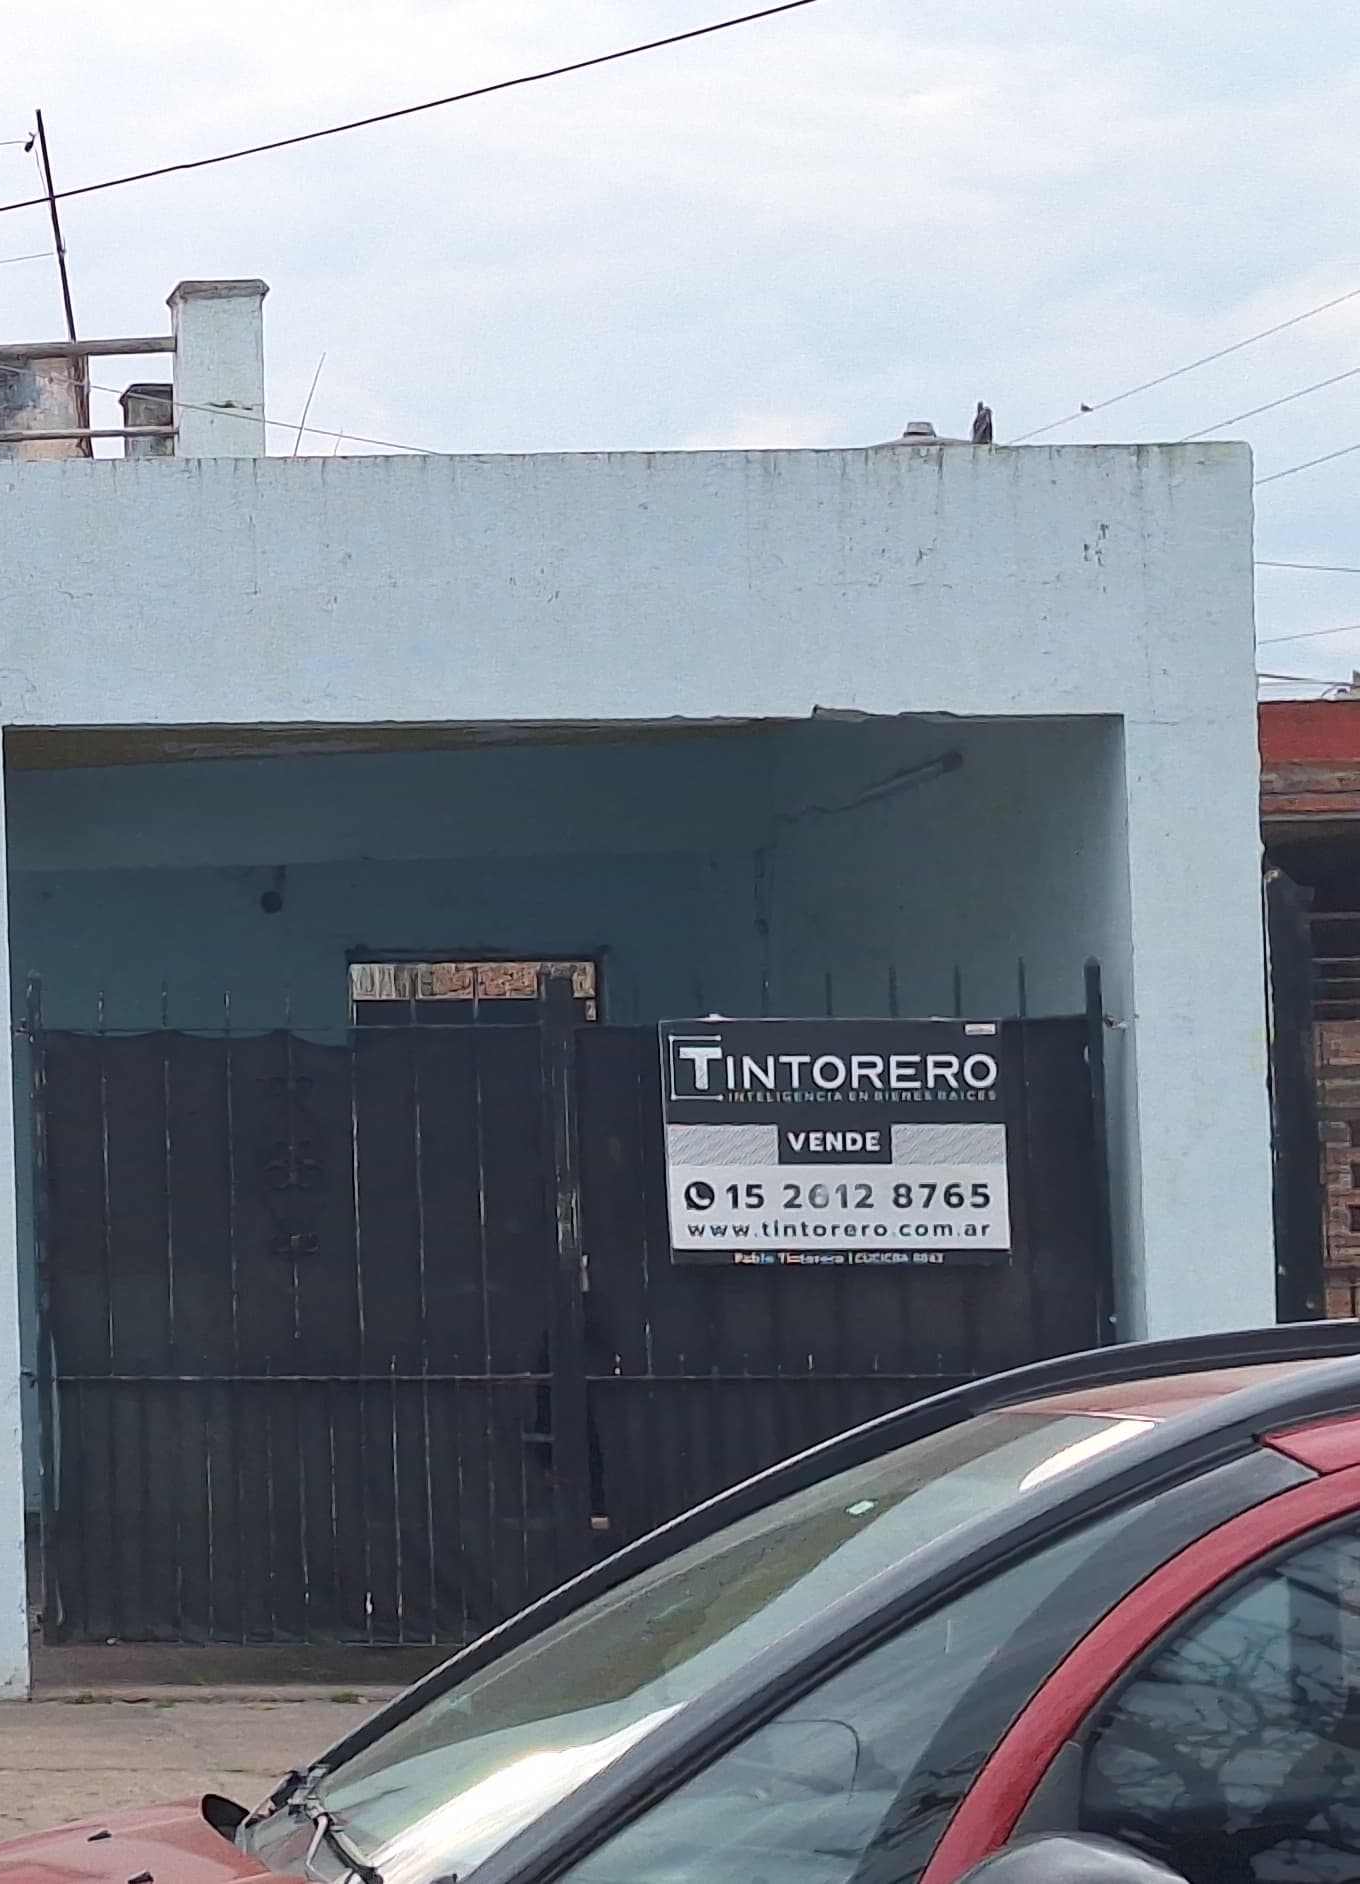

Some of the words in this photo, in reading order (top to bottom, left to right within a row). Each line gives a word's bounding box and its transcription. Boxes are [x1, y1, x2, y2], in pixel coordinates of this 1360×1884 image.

[679, 1046, 998, 1090] TINTORERO
[728, 1091, 843, 1103] INTELIGENCIA
[848, 1090, 869, 1102] EN
[787, 1131, 881, 1152] VENDE
[725, 1183, 764, 1209] 15
[782, 1183, 875, 1209] 2612
[892, 1183, 991, 1209] 8765
[688, 1219, 991, 1238] www.tintorero.com.ar
